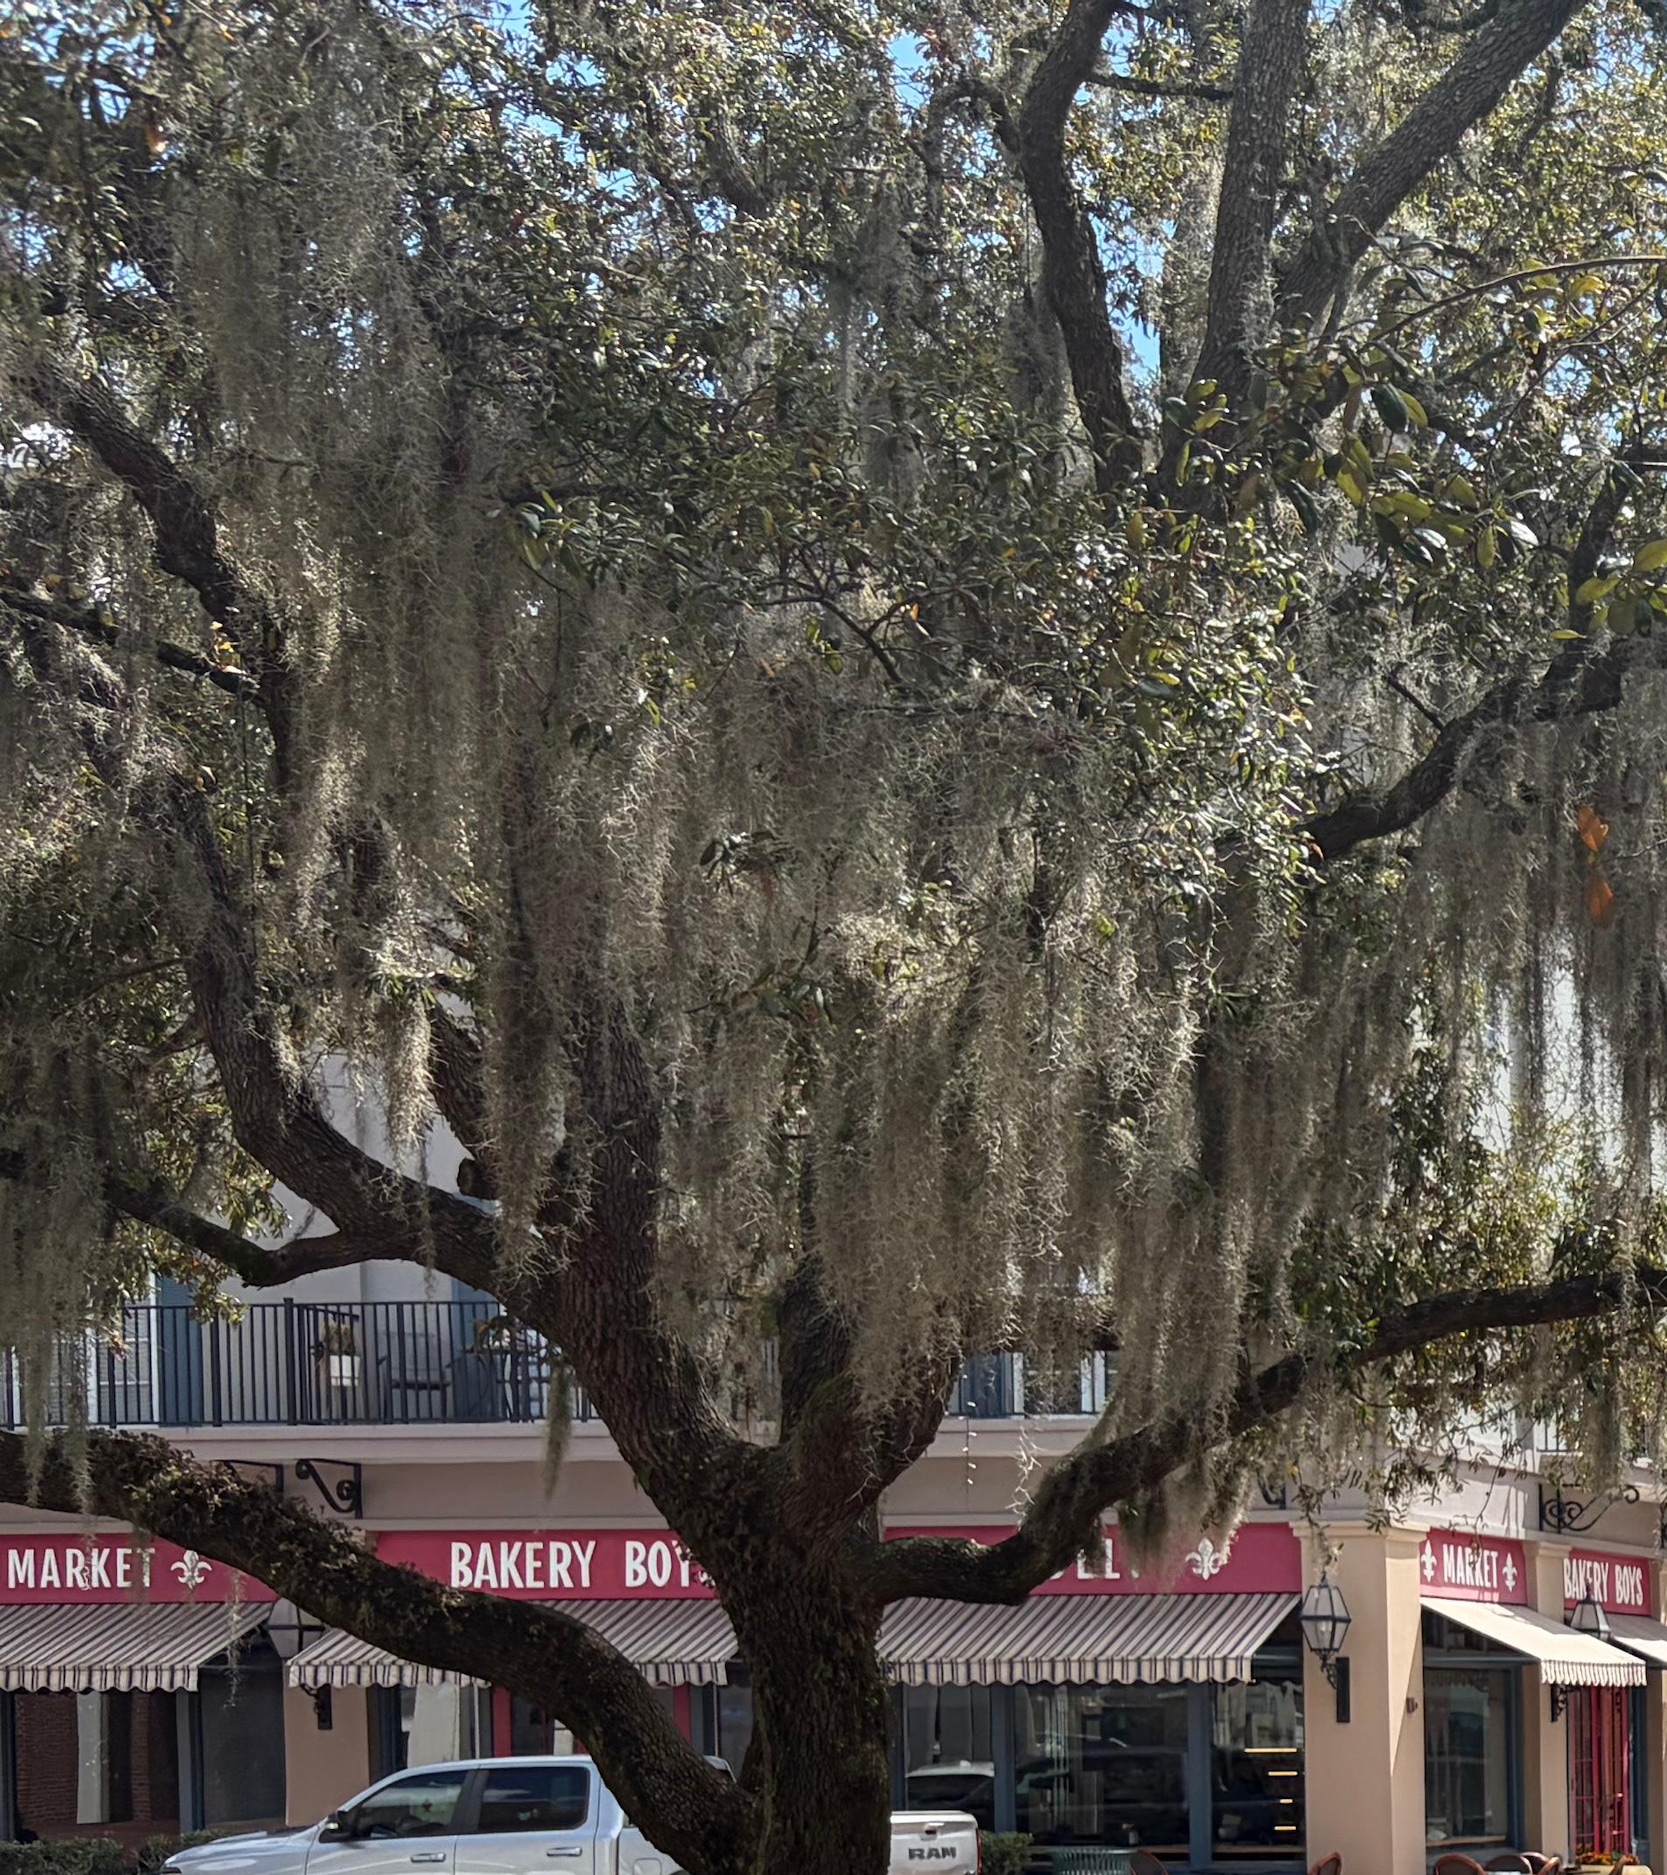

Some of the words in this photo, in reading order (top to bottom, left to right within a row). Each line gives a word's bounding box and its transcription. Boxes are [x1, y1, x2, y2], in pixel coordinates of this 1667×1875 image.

[8, 1548, 156, 1589] MARKET
[451, 1541, 596, 1588] BAKERY
[1443, 1543, 1499, 1589] MARKET
[1615, 1564, 1643, 1606] BOYS
[908, 1846, 957, 1860] RAM
